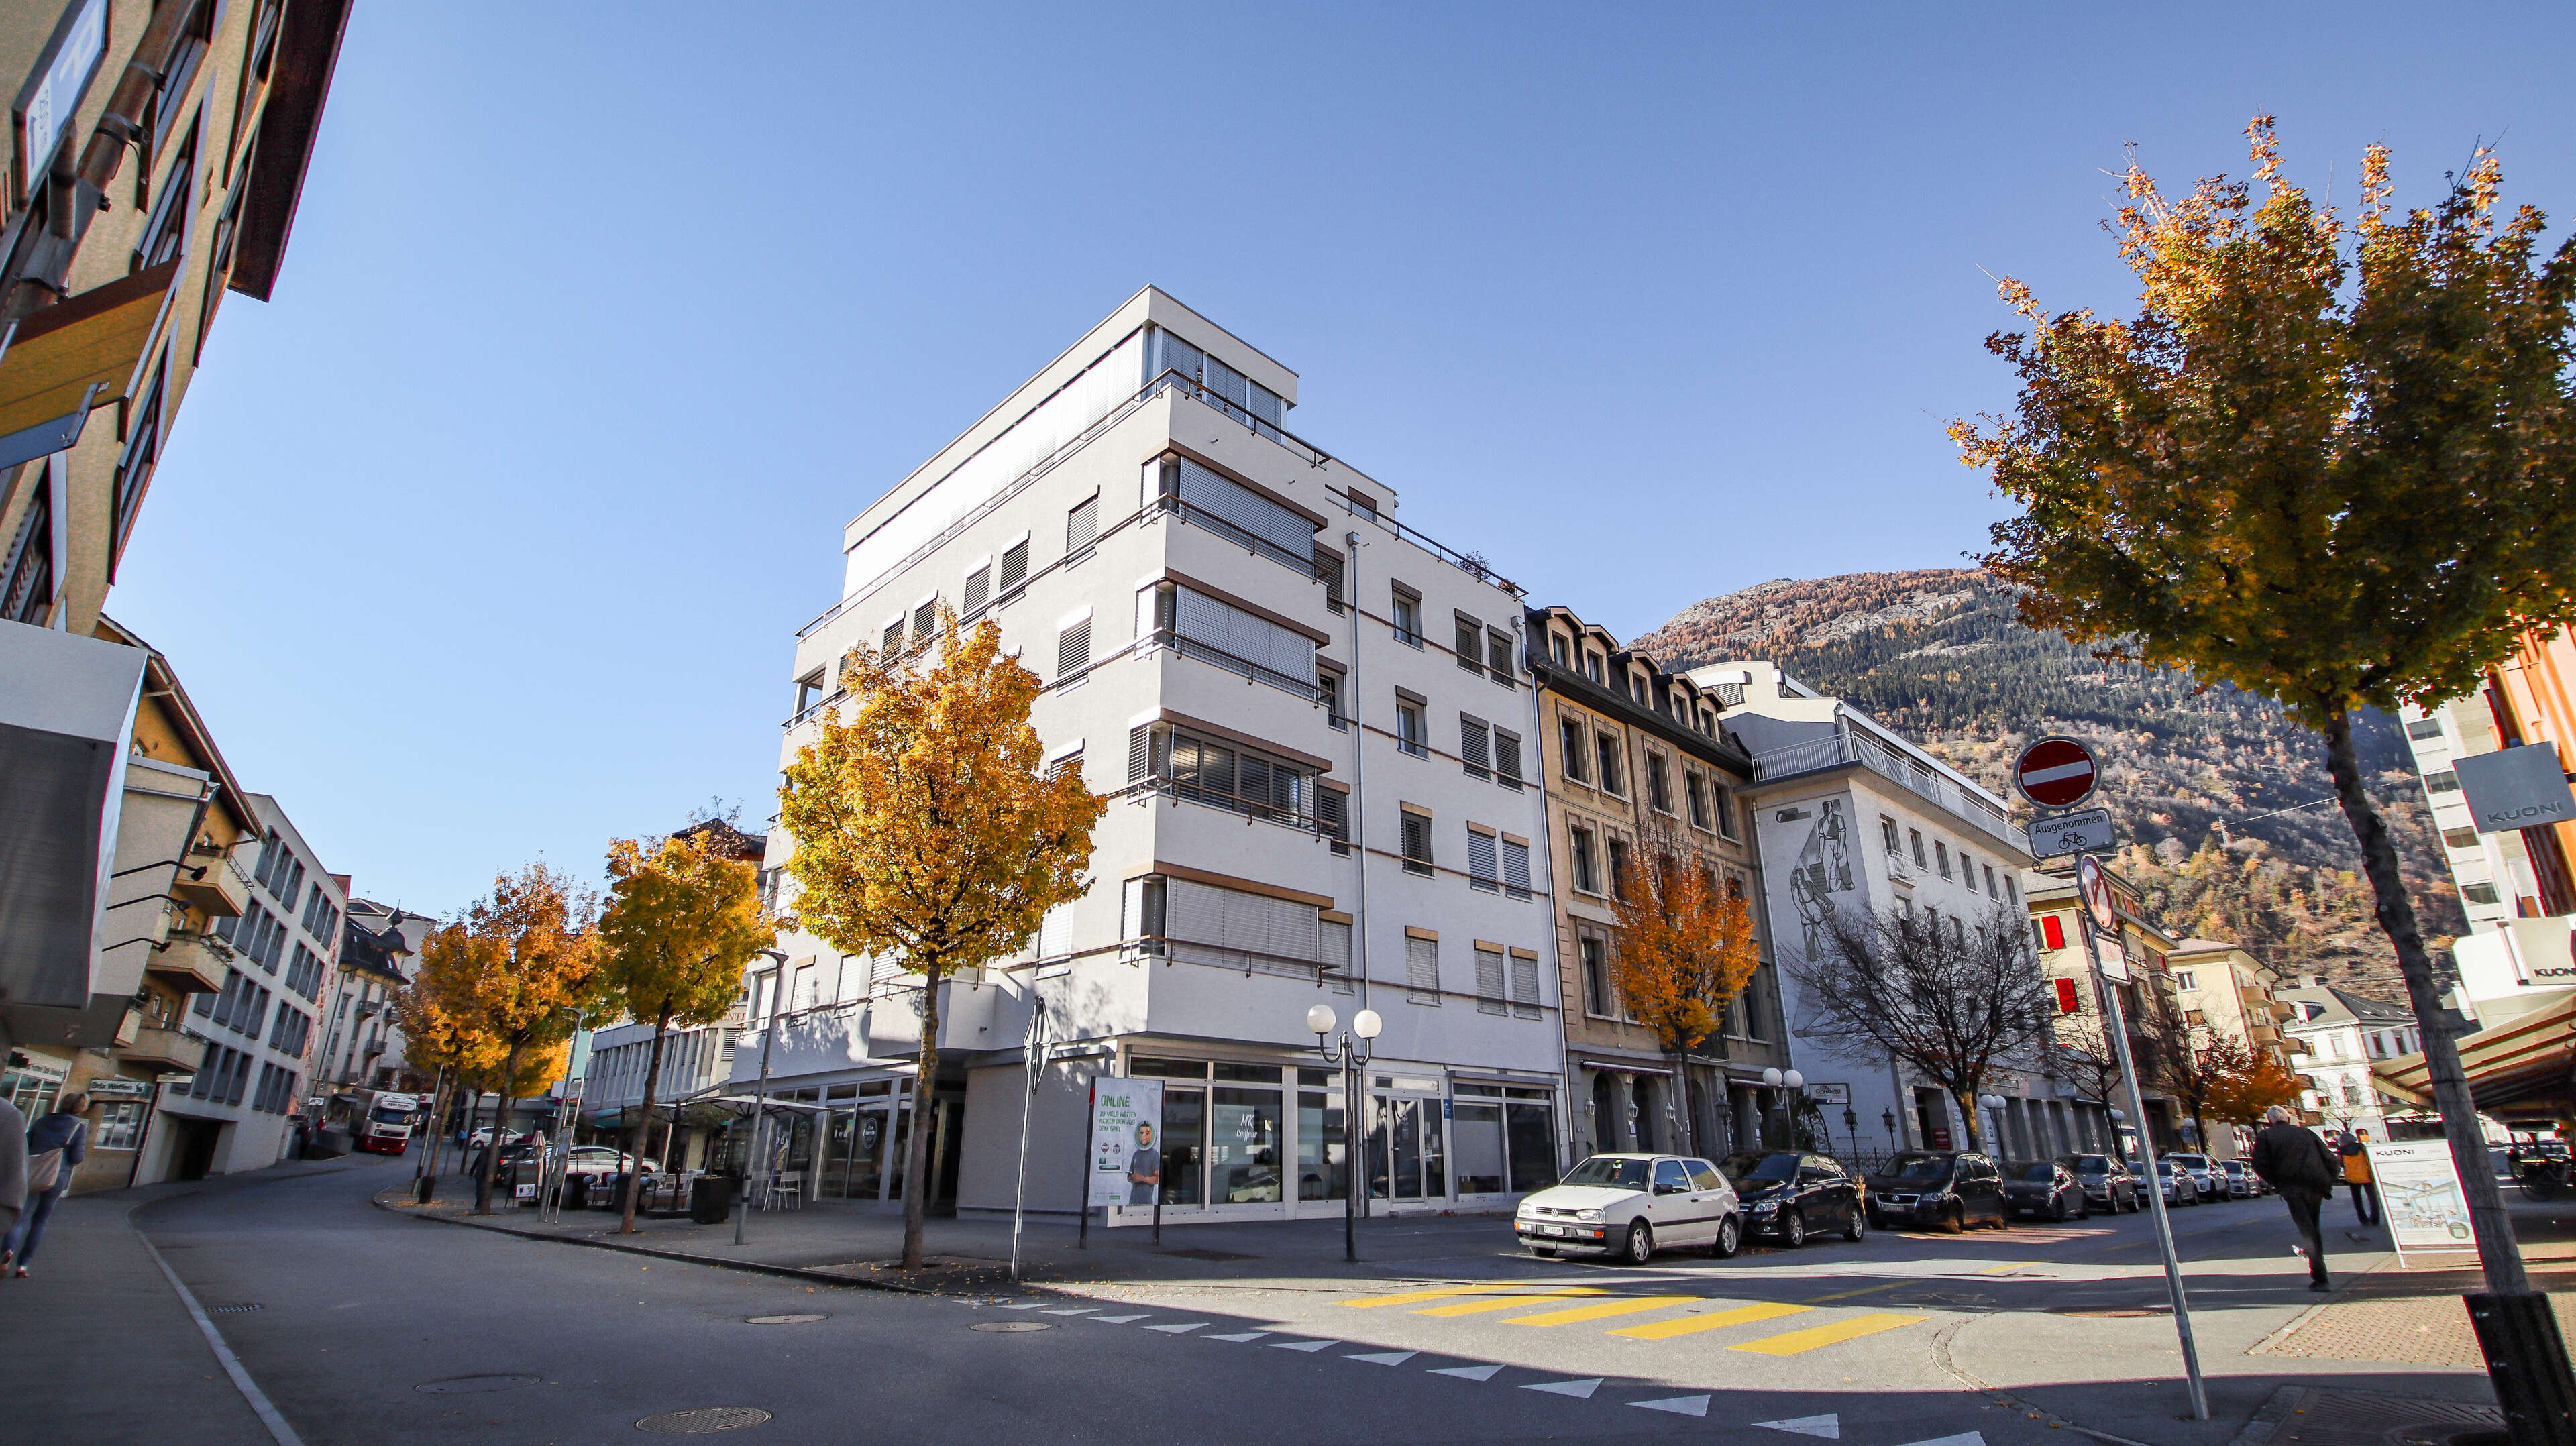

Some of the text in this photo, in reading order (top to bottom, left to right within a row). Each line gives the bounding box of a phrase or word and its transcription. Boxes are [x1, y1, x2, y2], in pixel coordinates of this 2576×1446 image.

[2487, 801, 2562, 824] KUONI
[2035, 815, 2103, 834] Ausgenommen
[1101, 1095, 1130, 1107] ONLINE
[1240, 1113, 1254, 1128] MK
[1236, 1128, 1257, 1142] Coiffeur
